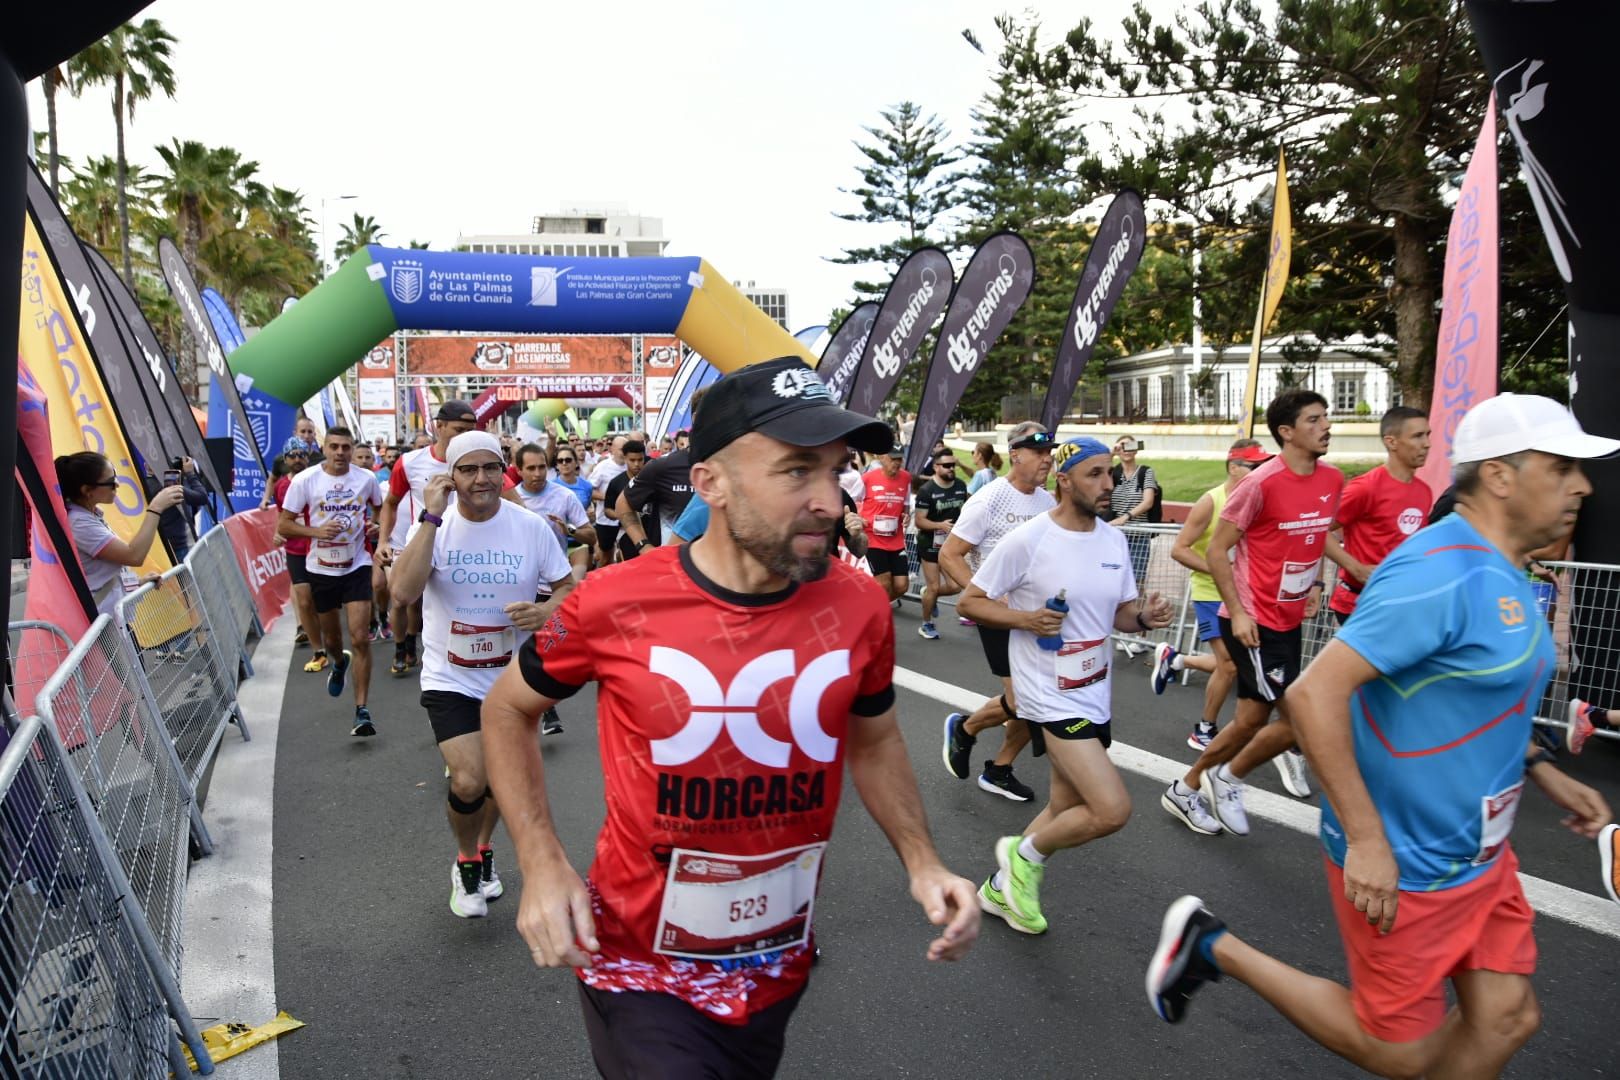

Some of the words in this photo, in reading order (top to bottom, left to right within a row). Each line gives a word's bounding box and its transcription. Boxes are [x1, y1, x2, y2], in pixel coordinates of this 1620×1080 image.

[429, 270, 513, 282] Ayuntamiento
[1091, 232, 1130, 312] EVENTOS
[429, 280, 443, 291] de
[449, 281, 468, 292] Las
[473, 282, 513, 294] Palmas
[429, 291, 443, 302] de
[445, 292, 470, 303] Gran
[473, 293, 513, 304] Canaria
[576, 291, 588, 299] Las
[589, 291, 614, 299] Palmas
[615, 291, 625, 299] de
[626, 291, 645, 299] Gran
[646, 291, 673, 300] Canaria
[966, 268, 1013, 340] EVENTOS
[890, 280, 934, 349] EVENTOS
[514, 342, 551, 353] CARRERA
[551, 342, 562, 353] DE
[514, 353, 530, 364] LAS
[530, 353, 571, 364] EMPRESAS
[447, 549, 524, 570] Healthy
[451, 568, 519, 585] Coach
[470, 641, 493, 654] 1740
[656, 769, 826, 822] HORCASA
[729, 894, 768, 922] 523
